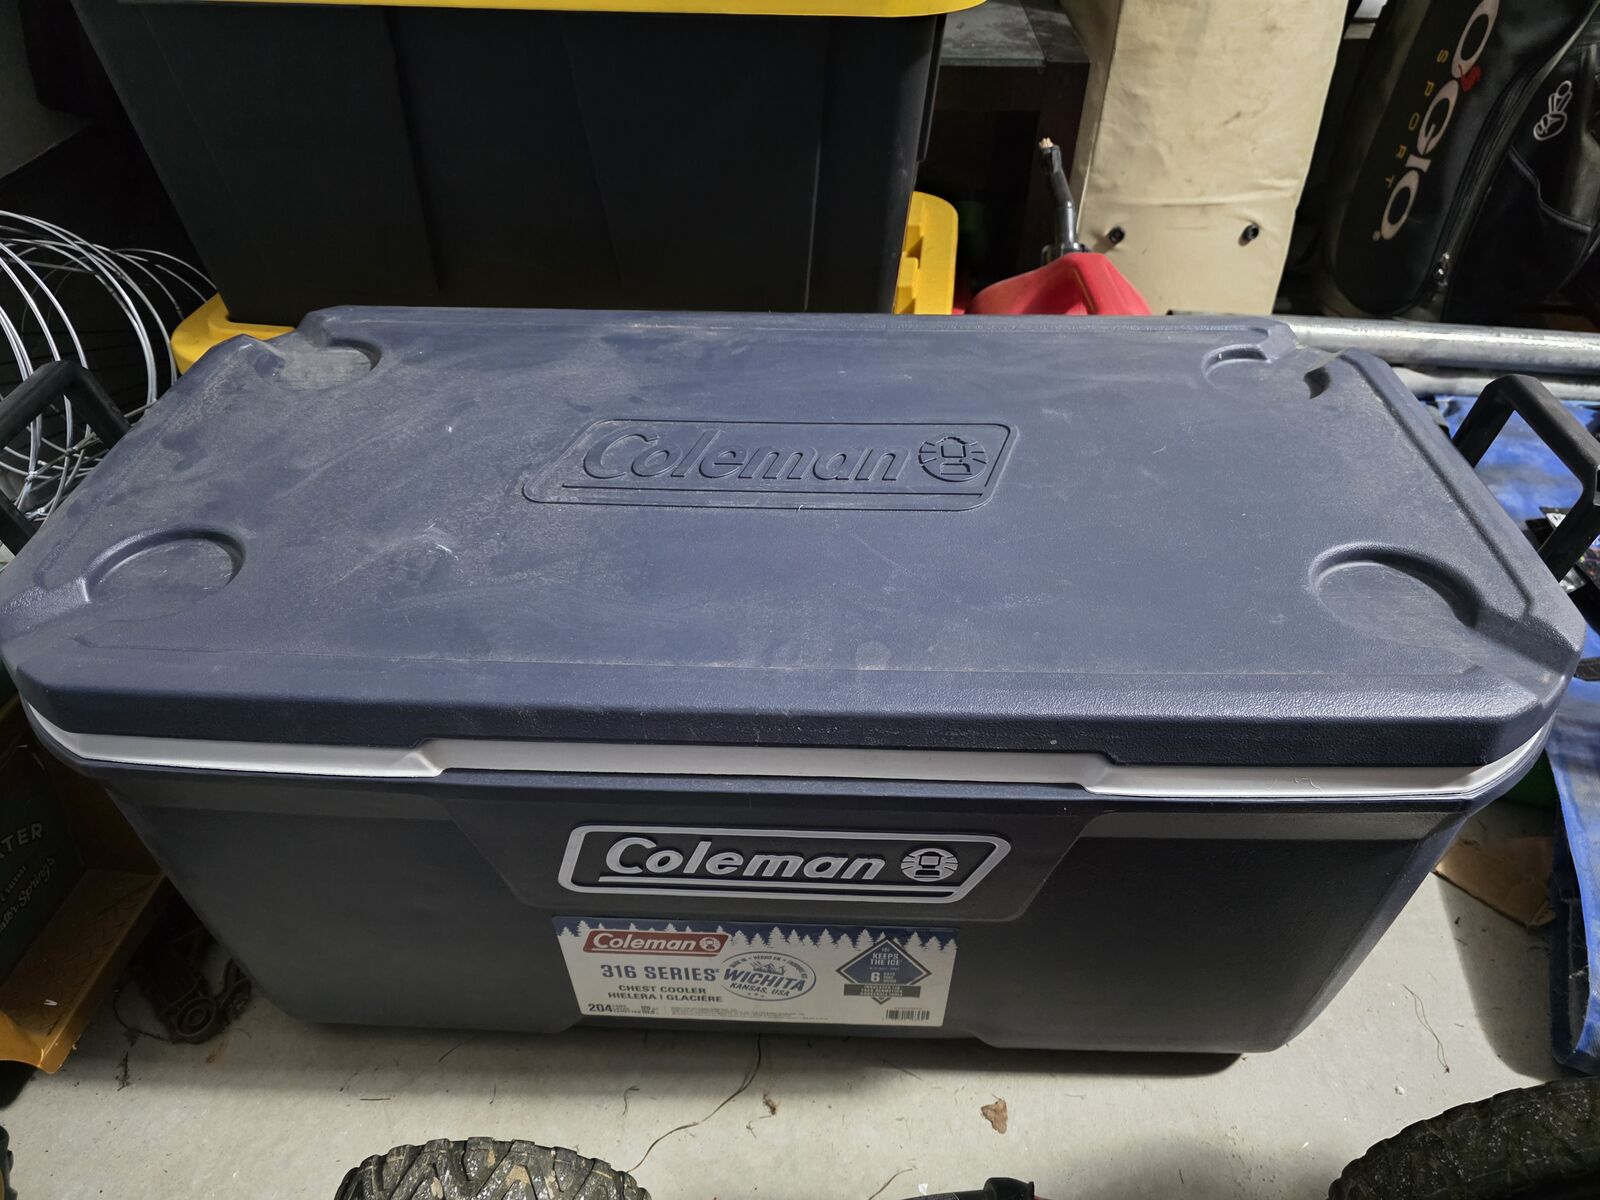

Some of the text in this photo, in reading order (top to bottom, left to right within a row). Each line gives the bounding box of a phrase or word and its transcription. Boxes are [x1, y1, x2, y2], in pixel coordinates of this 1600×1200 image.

[1379, 0, 1500, 240] OGIO
[1385, 49, 1450, 188] SPORT
[582, 428, 908, 482] Coleman
[605, 836, 886, 881] Coleman
[592, 932, 697, 951] Coleman
[600, 964, 637, 979] 316
[723, 968, 806, 992] WICHITA
[870, 971, 881, 983] 6
[608, 992, 657, 1000] HIELERA
[618, 984, 706, 994] CHEST COOLER
[771, 988, 791, 997] USA
[588, 1003, 613, 1013] 204
